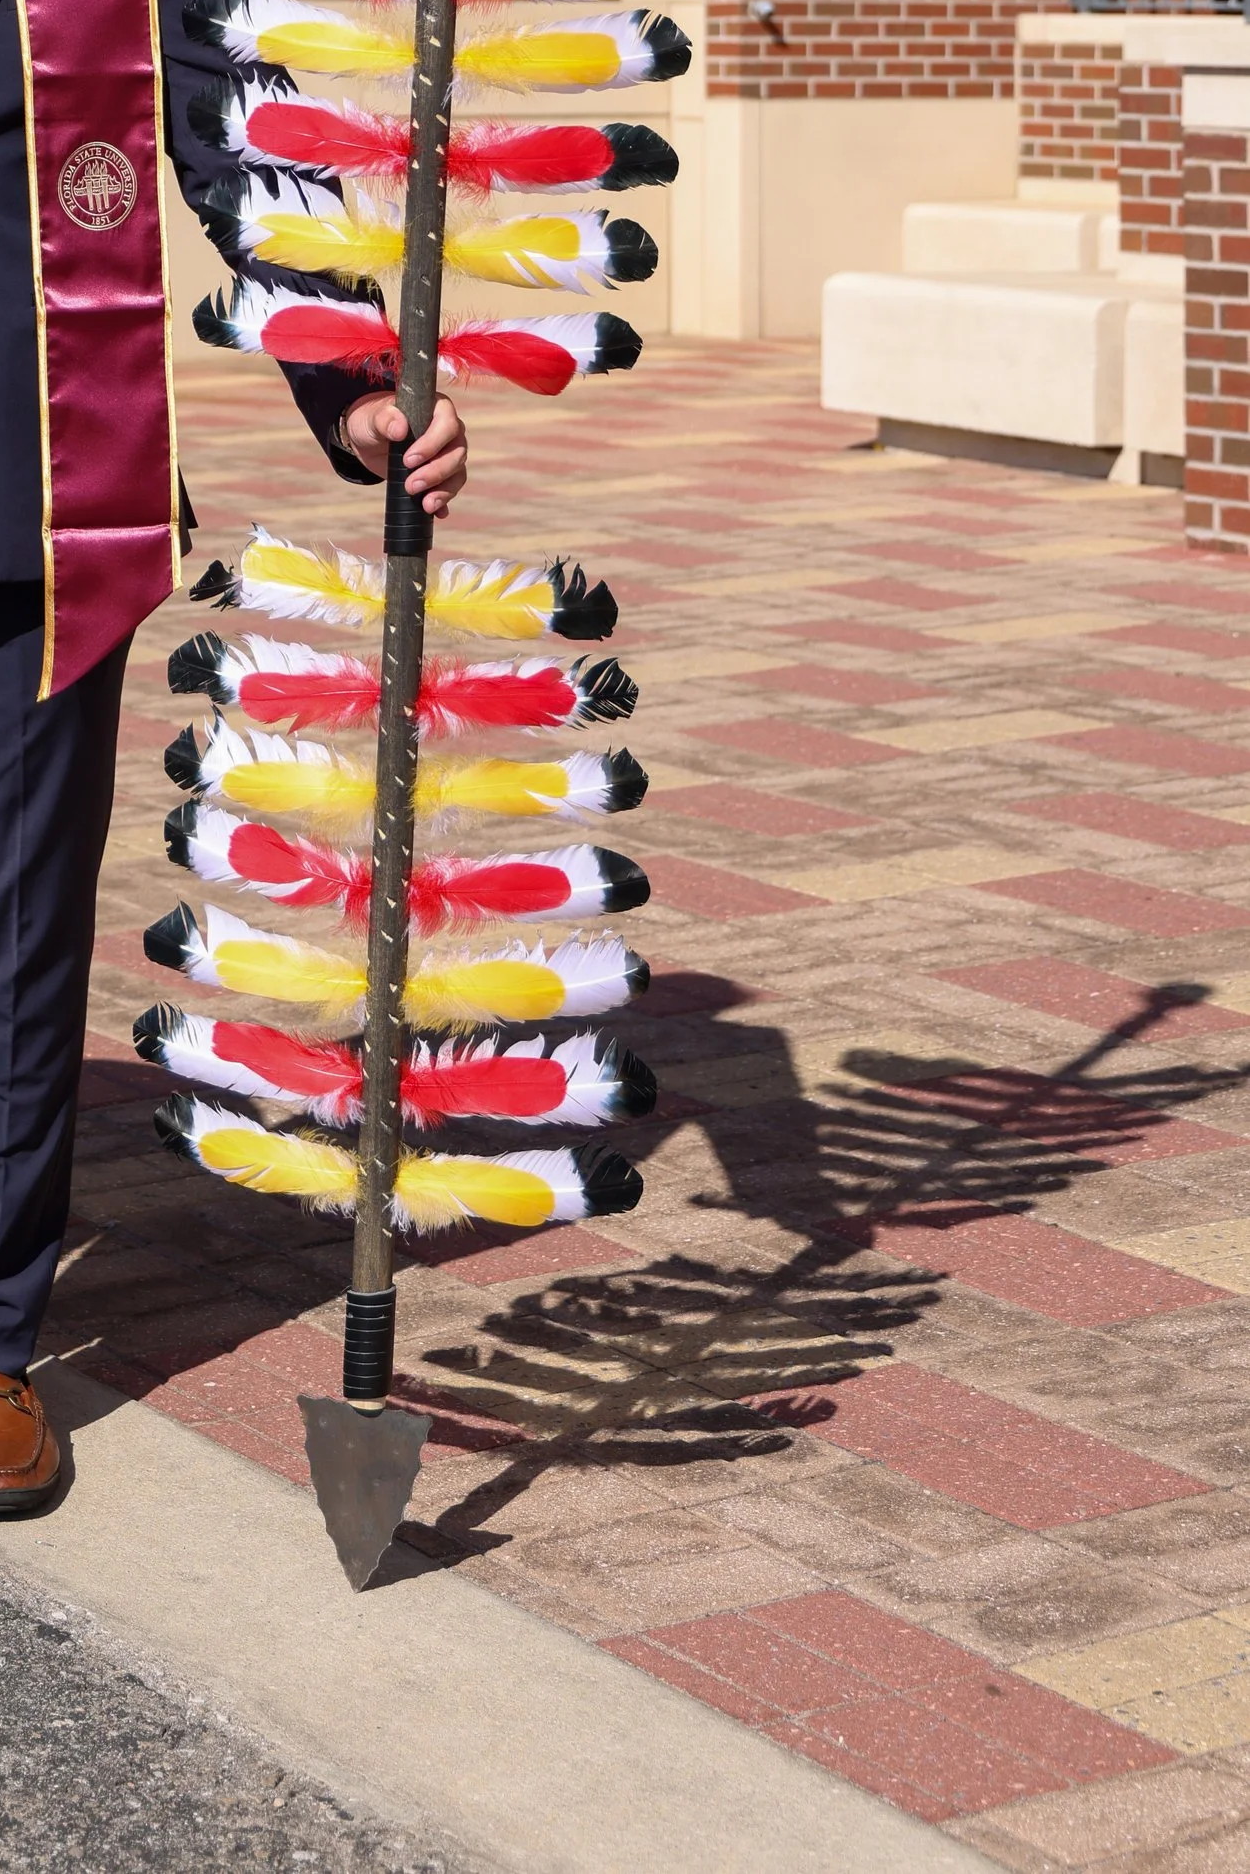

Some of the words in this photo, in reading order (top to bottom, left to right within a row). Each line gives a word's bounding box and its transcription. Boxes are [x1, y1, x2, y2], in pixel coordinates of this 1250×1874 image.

[63, 164, 77, 211] FLORIDA
[75, 147, 102, 164] STATE
[104, 149, 133, 208] UNIVERSITY
[91, 216, 111, 226] 1851
